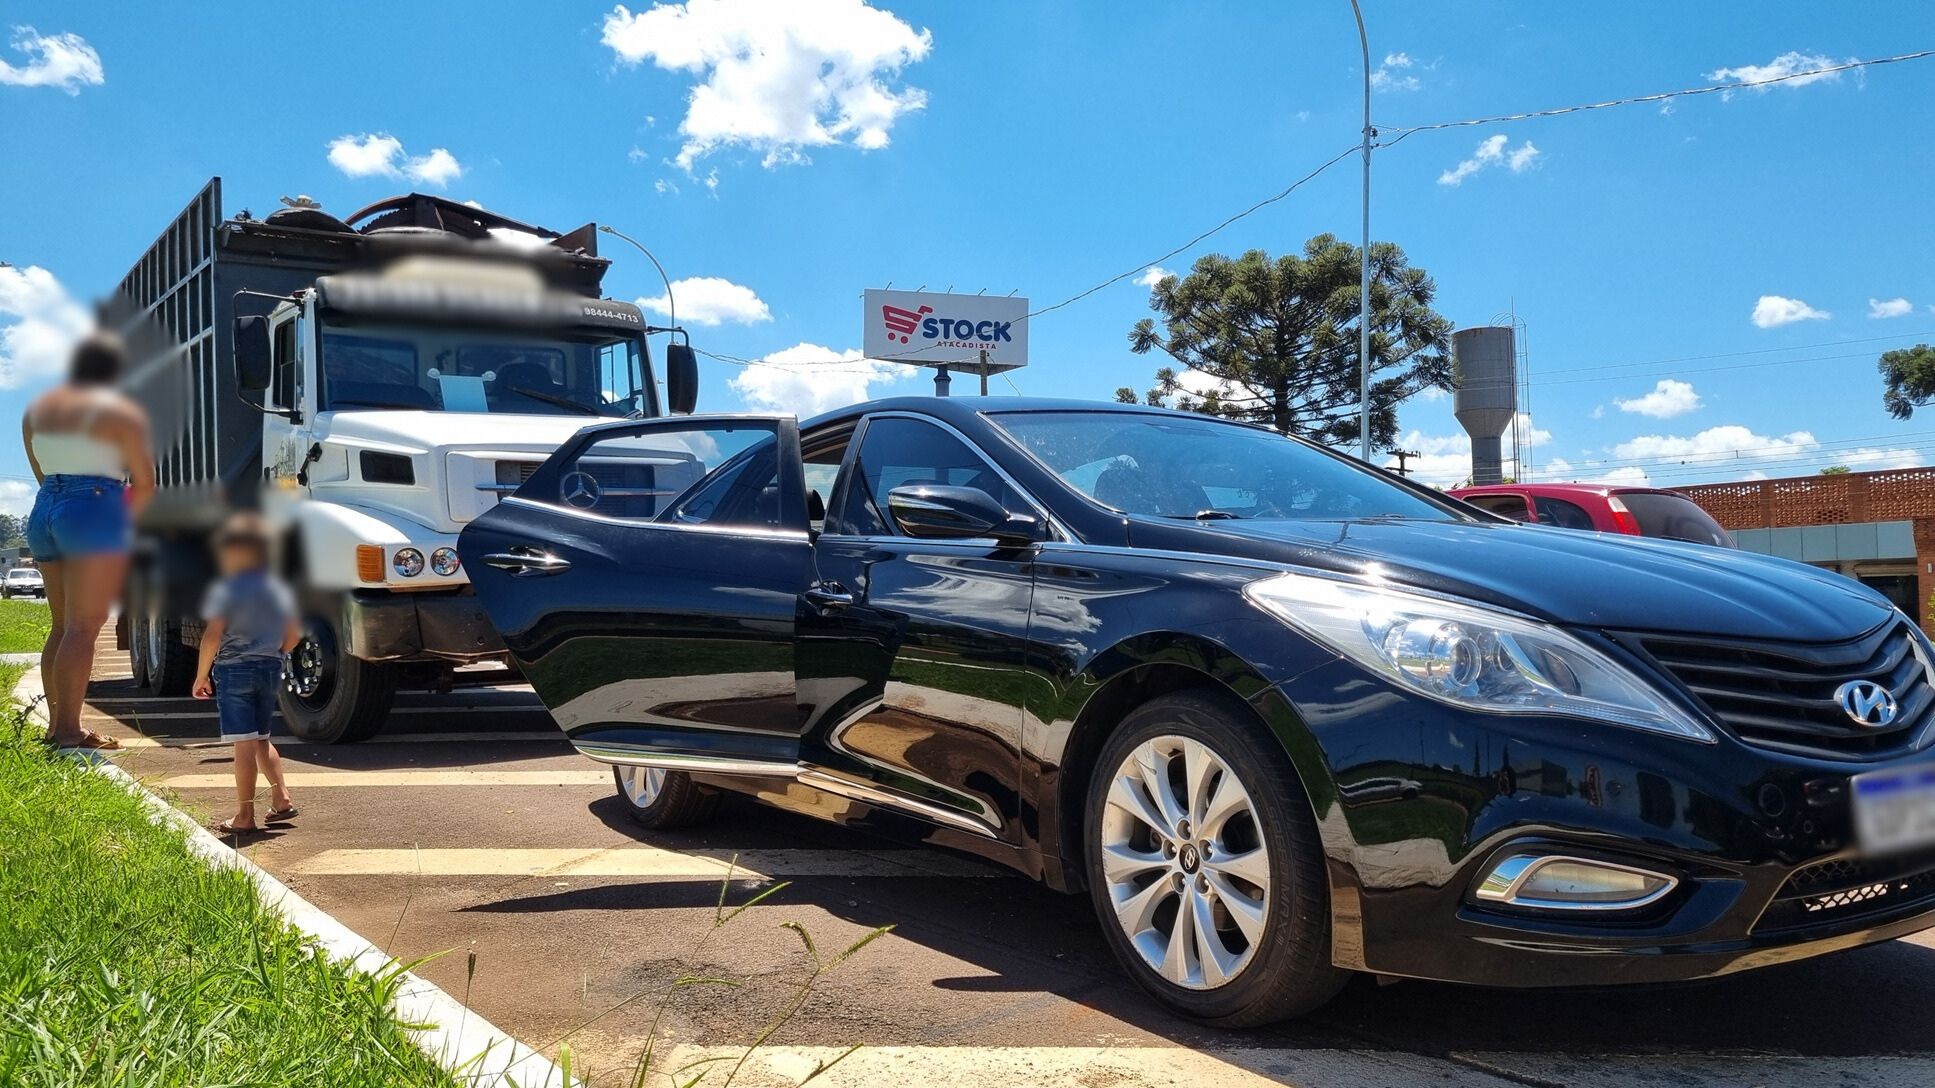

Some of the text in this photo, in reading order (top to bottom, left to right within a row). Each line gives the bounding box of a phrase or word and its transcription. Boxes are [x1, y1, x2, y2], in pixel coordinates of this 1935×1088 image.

[584, 307, 639, 323] 98444-4713
[922, 318, 1012, 342] STOCK
[937, 341, 997, 350] ATACADISTA
